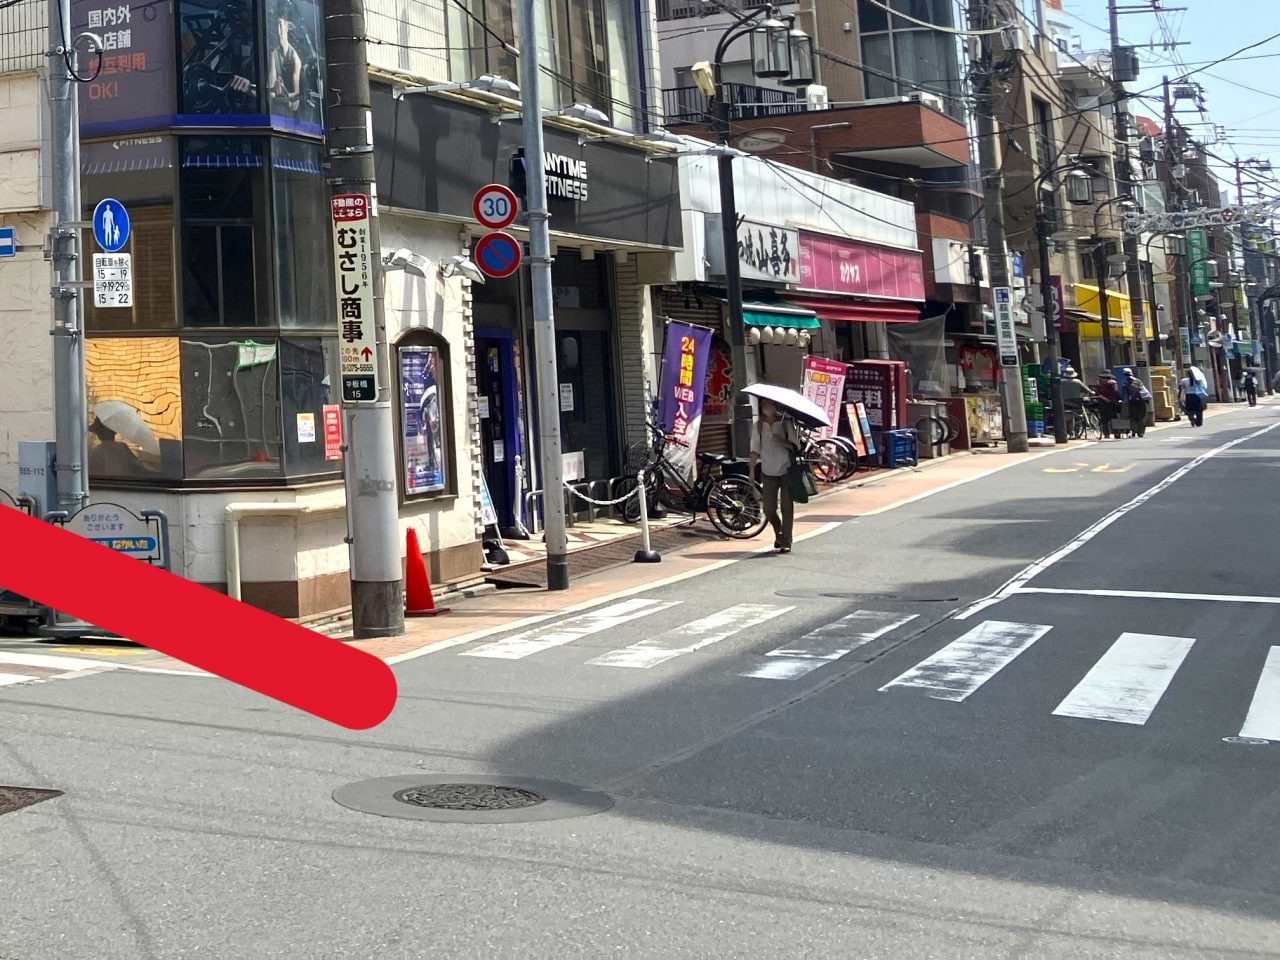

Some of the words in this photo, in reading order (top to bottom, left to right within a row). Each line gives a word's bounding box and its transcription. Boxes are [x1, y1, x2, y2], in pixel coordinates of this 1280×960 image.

[88, 5, 131, 28] 国内外
[89, 81, 118, 100] OK!
[483, 198, 508, 217] 30
[337, 228, 364, 343] むさし商事
[352, 390, 362, 398] 15
